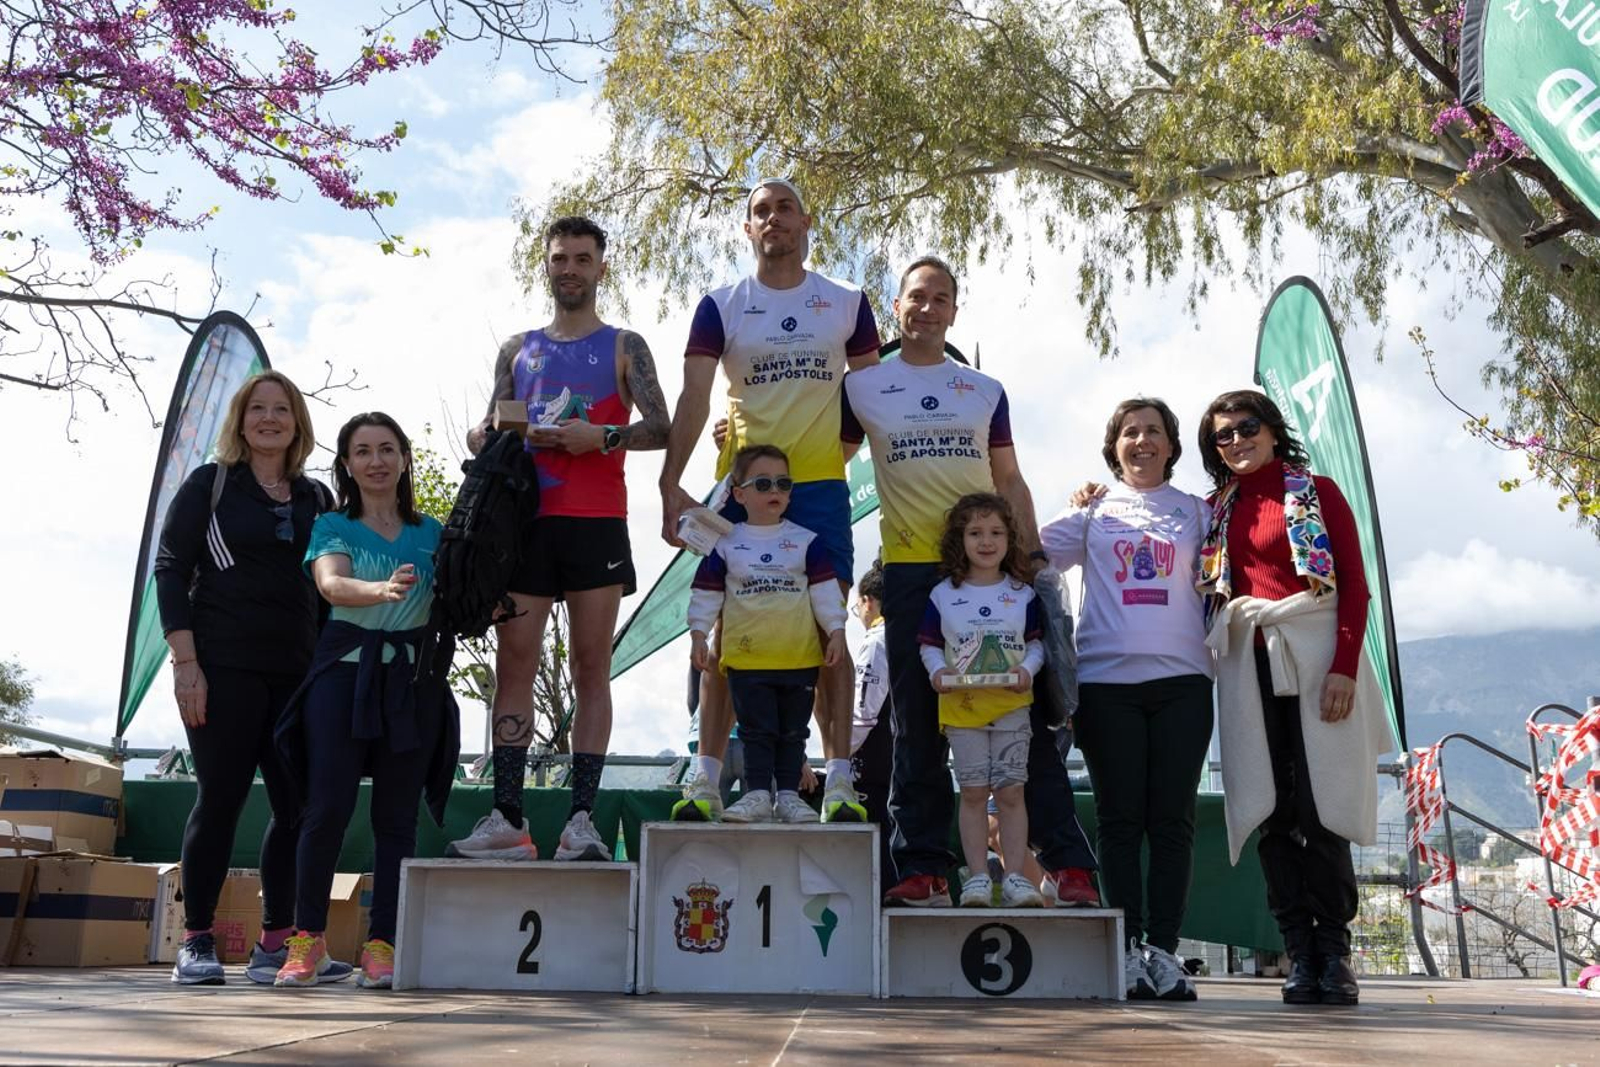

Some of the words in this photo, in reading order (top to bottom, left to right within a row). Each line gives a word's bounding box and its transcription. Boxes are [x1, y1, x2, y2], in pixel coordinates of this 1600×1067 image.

[753, 360, 792, 373] SANTA
[815, 358, 828, 368] DE
[744, 374, 767, 386] LOS
[888, 431, 913, 440] CLUB
[891, 437, 935, 449] SANTA
[959, 436, 974, 446] DE
[886, 451, 906, 463] LOS
[911, 447, 981, 459] APÓSTOLES
[856, 484, 877, 501] de
[757, 885, 771, 947] 1
[517, 910, 542, 974] 2
[981, 927, 1014, 992] 3
